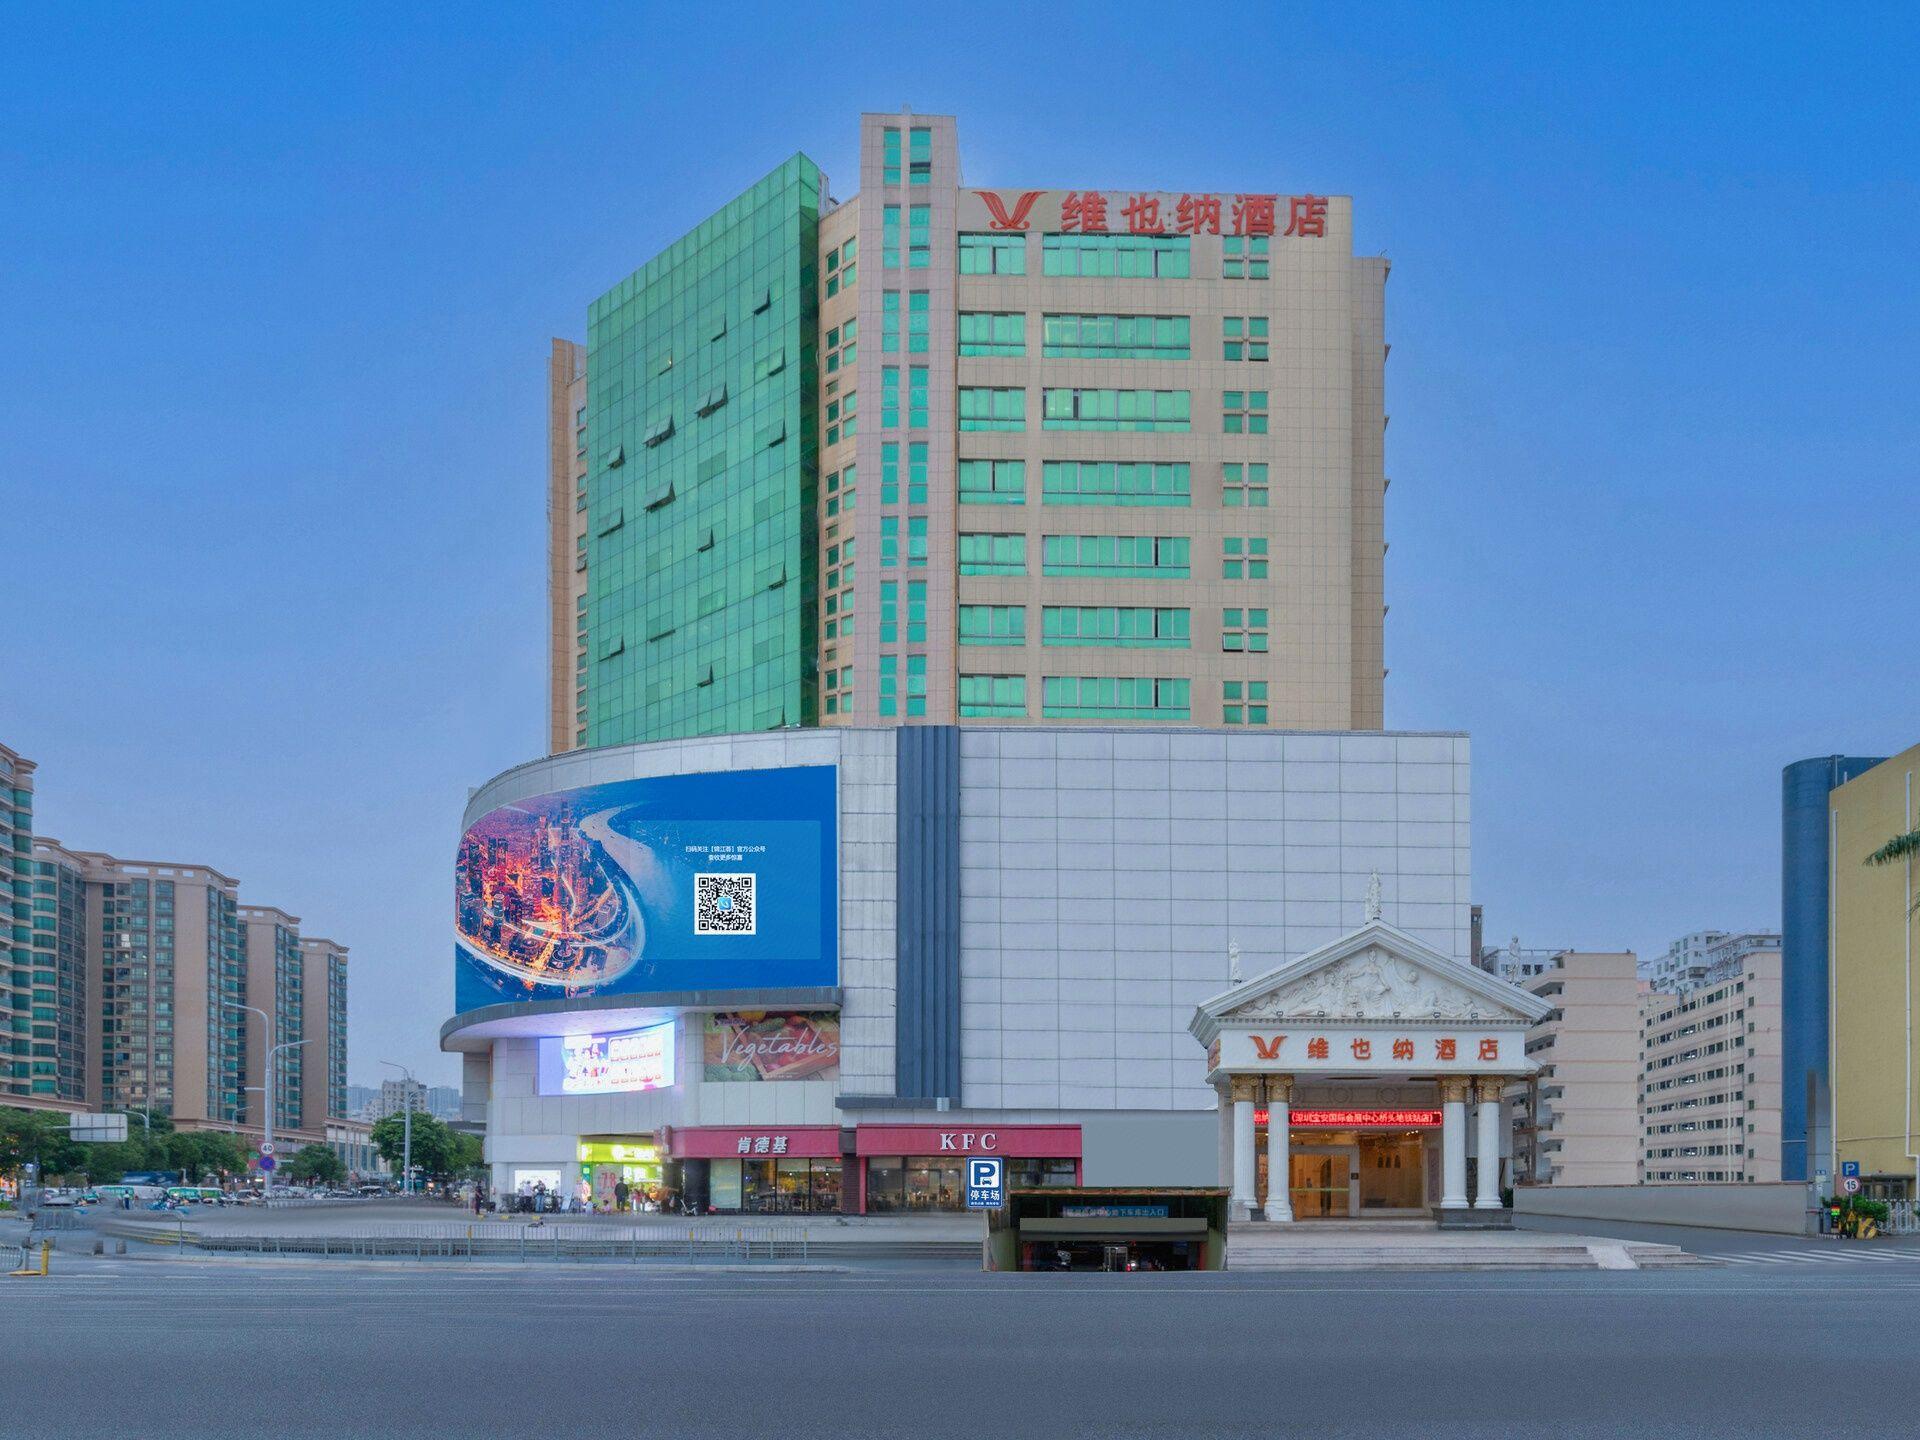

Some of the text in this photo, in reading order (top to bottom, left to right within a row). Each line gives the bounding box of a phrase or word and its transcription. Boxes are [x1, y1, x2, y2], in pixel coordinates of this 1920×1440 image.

[1061, 191, 1329, 237] 维也纳酒店
[721, 1026, 838, 1071] Vegetables
[1307, 1038, 1498, 1060] 维也纳酒店
[737, 1136, 788, 1154] 肯德基
[939, 1133, 997, 1150] KFC
[974, 1163, 996, 1186] P
[1846, 1163, 1855, 1175] P
[1846, 1181, 1856, 1190] 15
[970, 1190, 1000, 1201] 停车场
